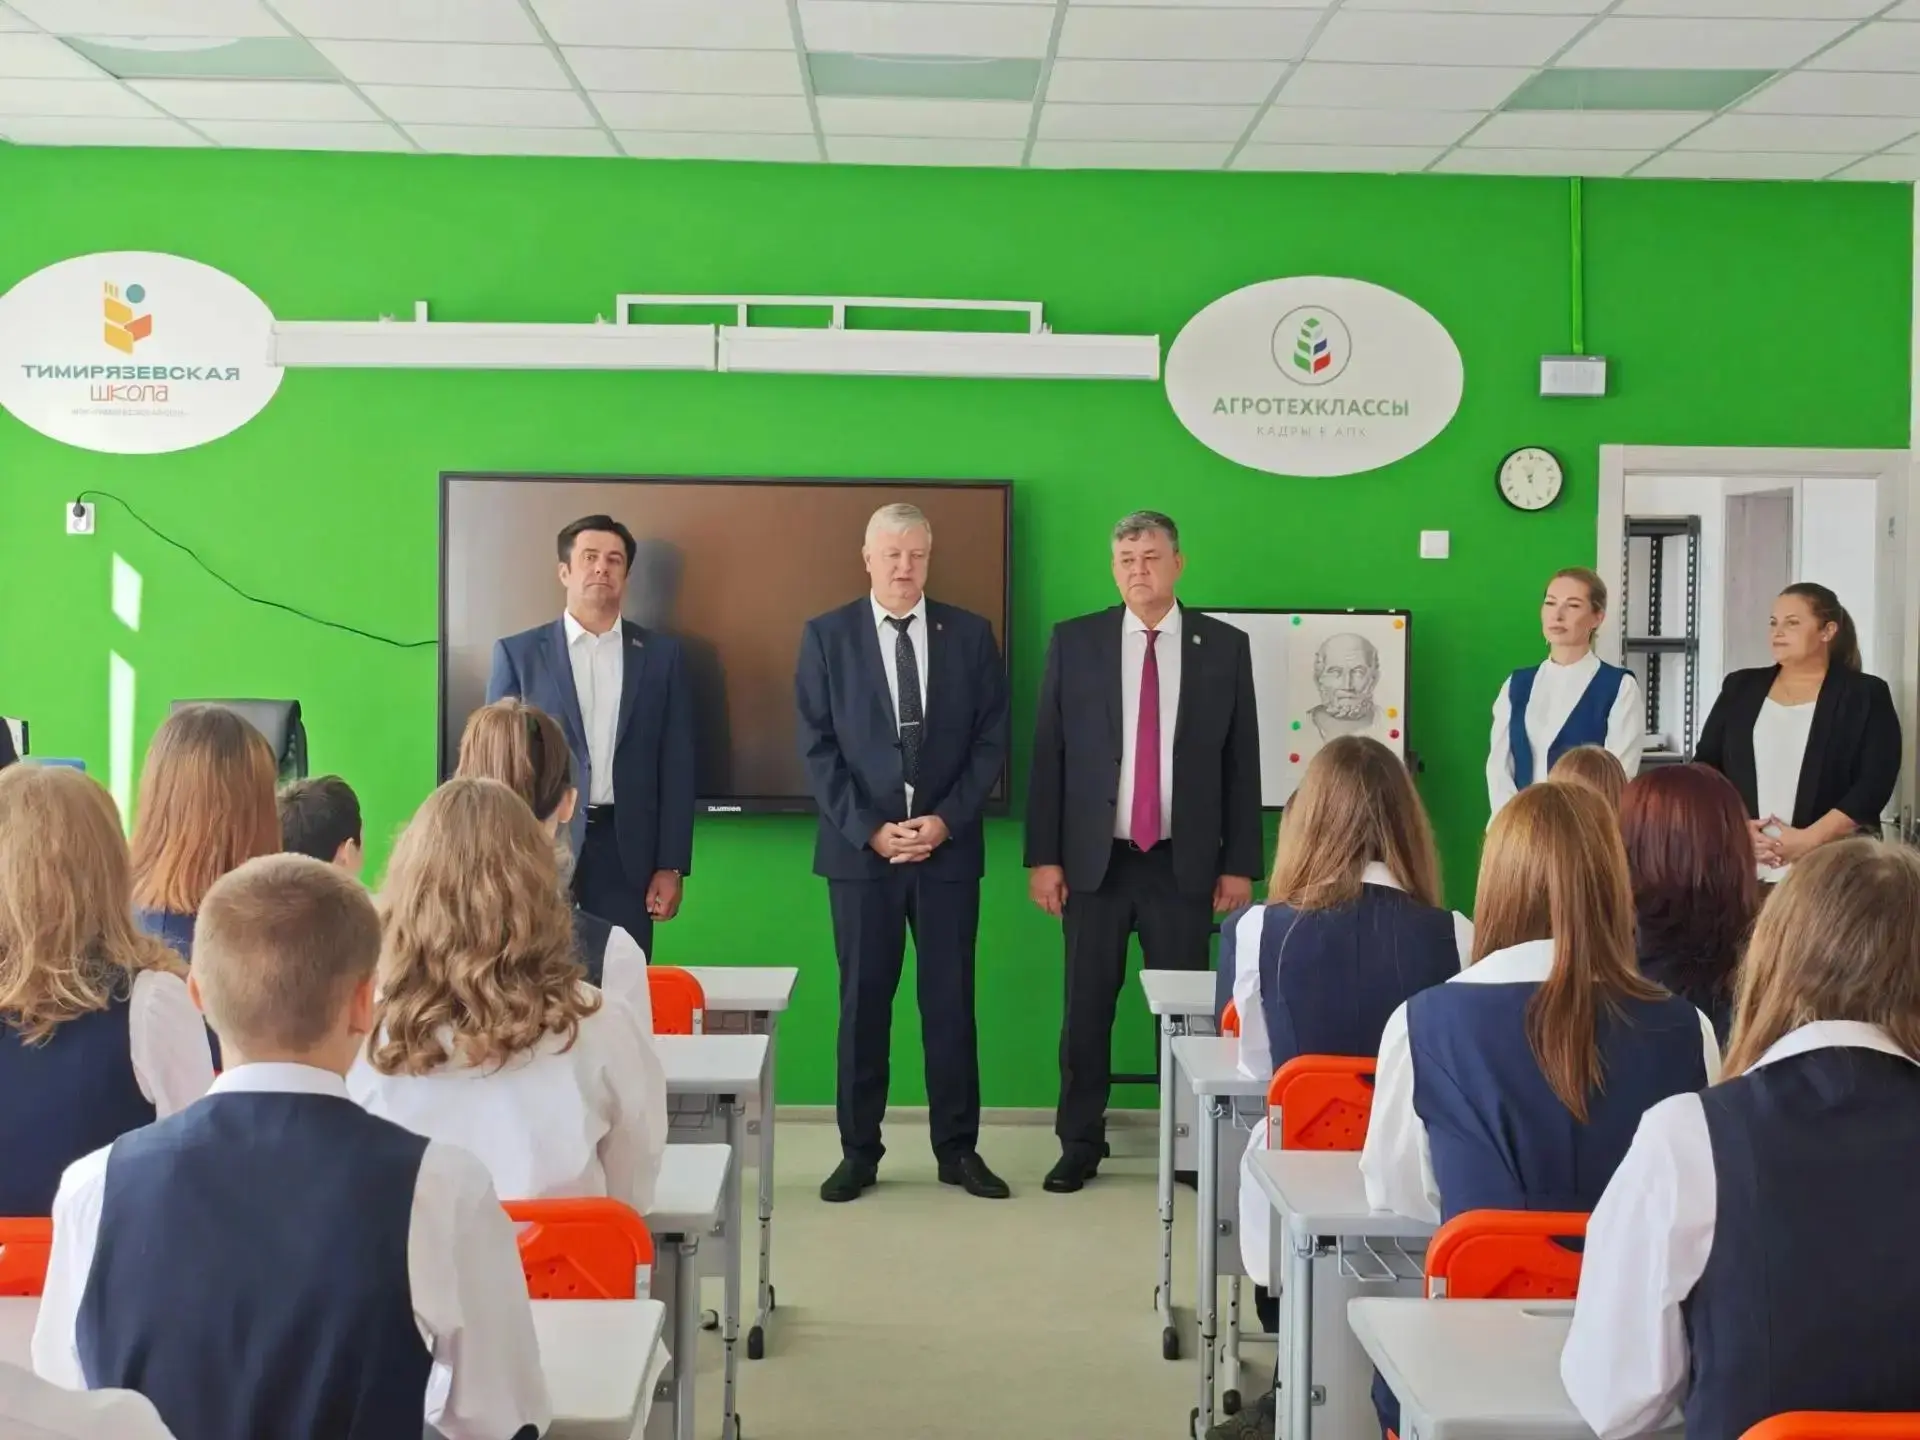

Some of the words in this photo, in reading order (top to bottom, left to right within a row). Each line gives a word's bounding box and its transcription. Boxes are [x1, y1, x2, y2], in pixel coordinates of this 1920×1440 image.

[21, 364, 241, 381] ТИМИРЯЗЕВСКАЯ
[1213, 397, 1409, 417] АГРОТЕХКЛАССЫ
[1256, 425, 1312, 438] КАДРЫ
[1334, 426, 1369, 438] АПК
